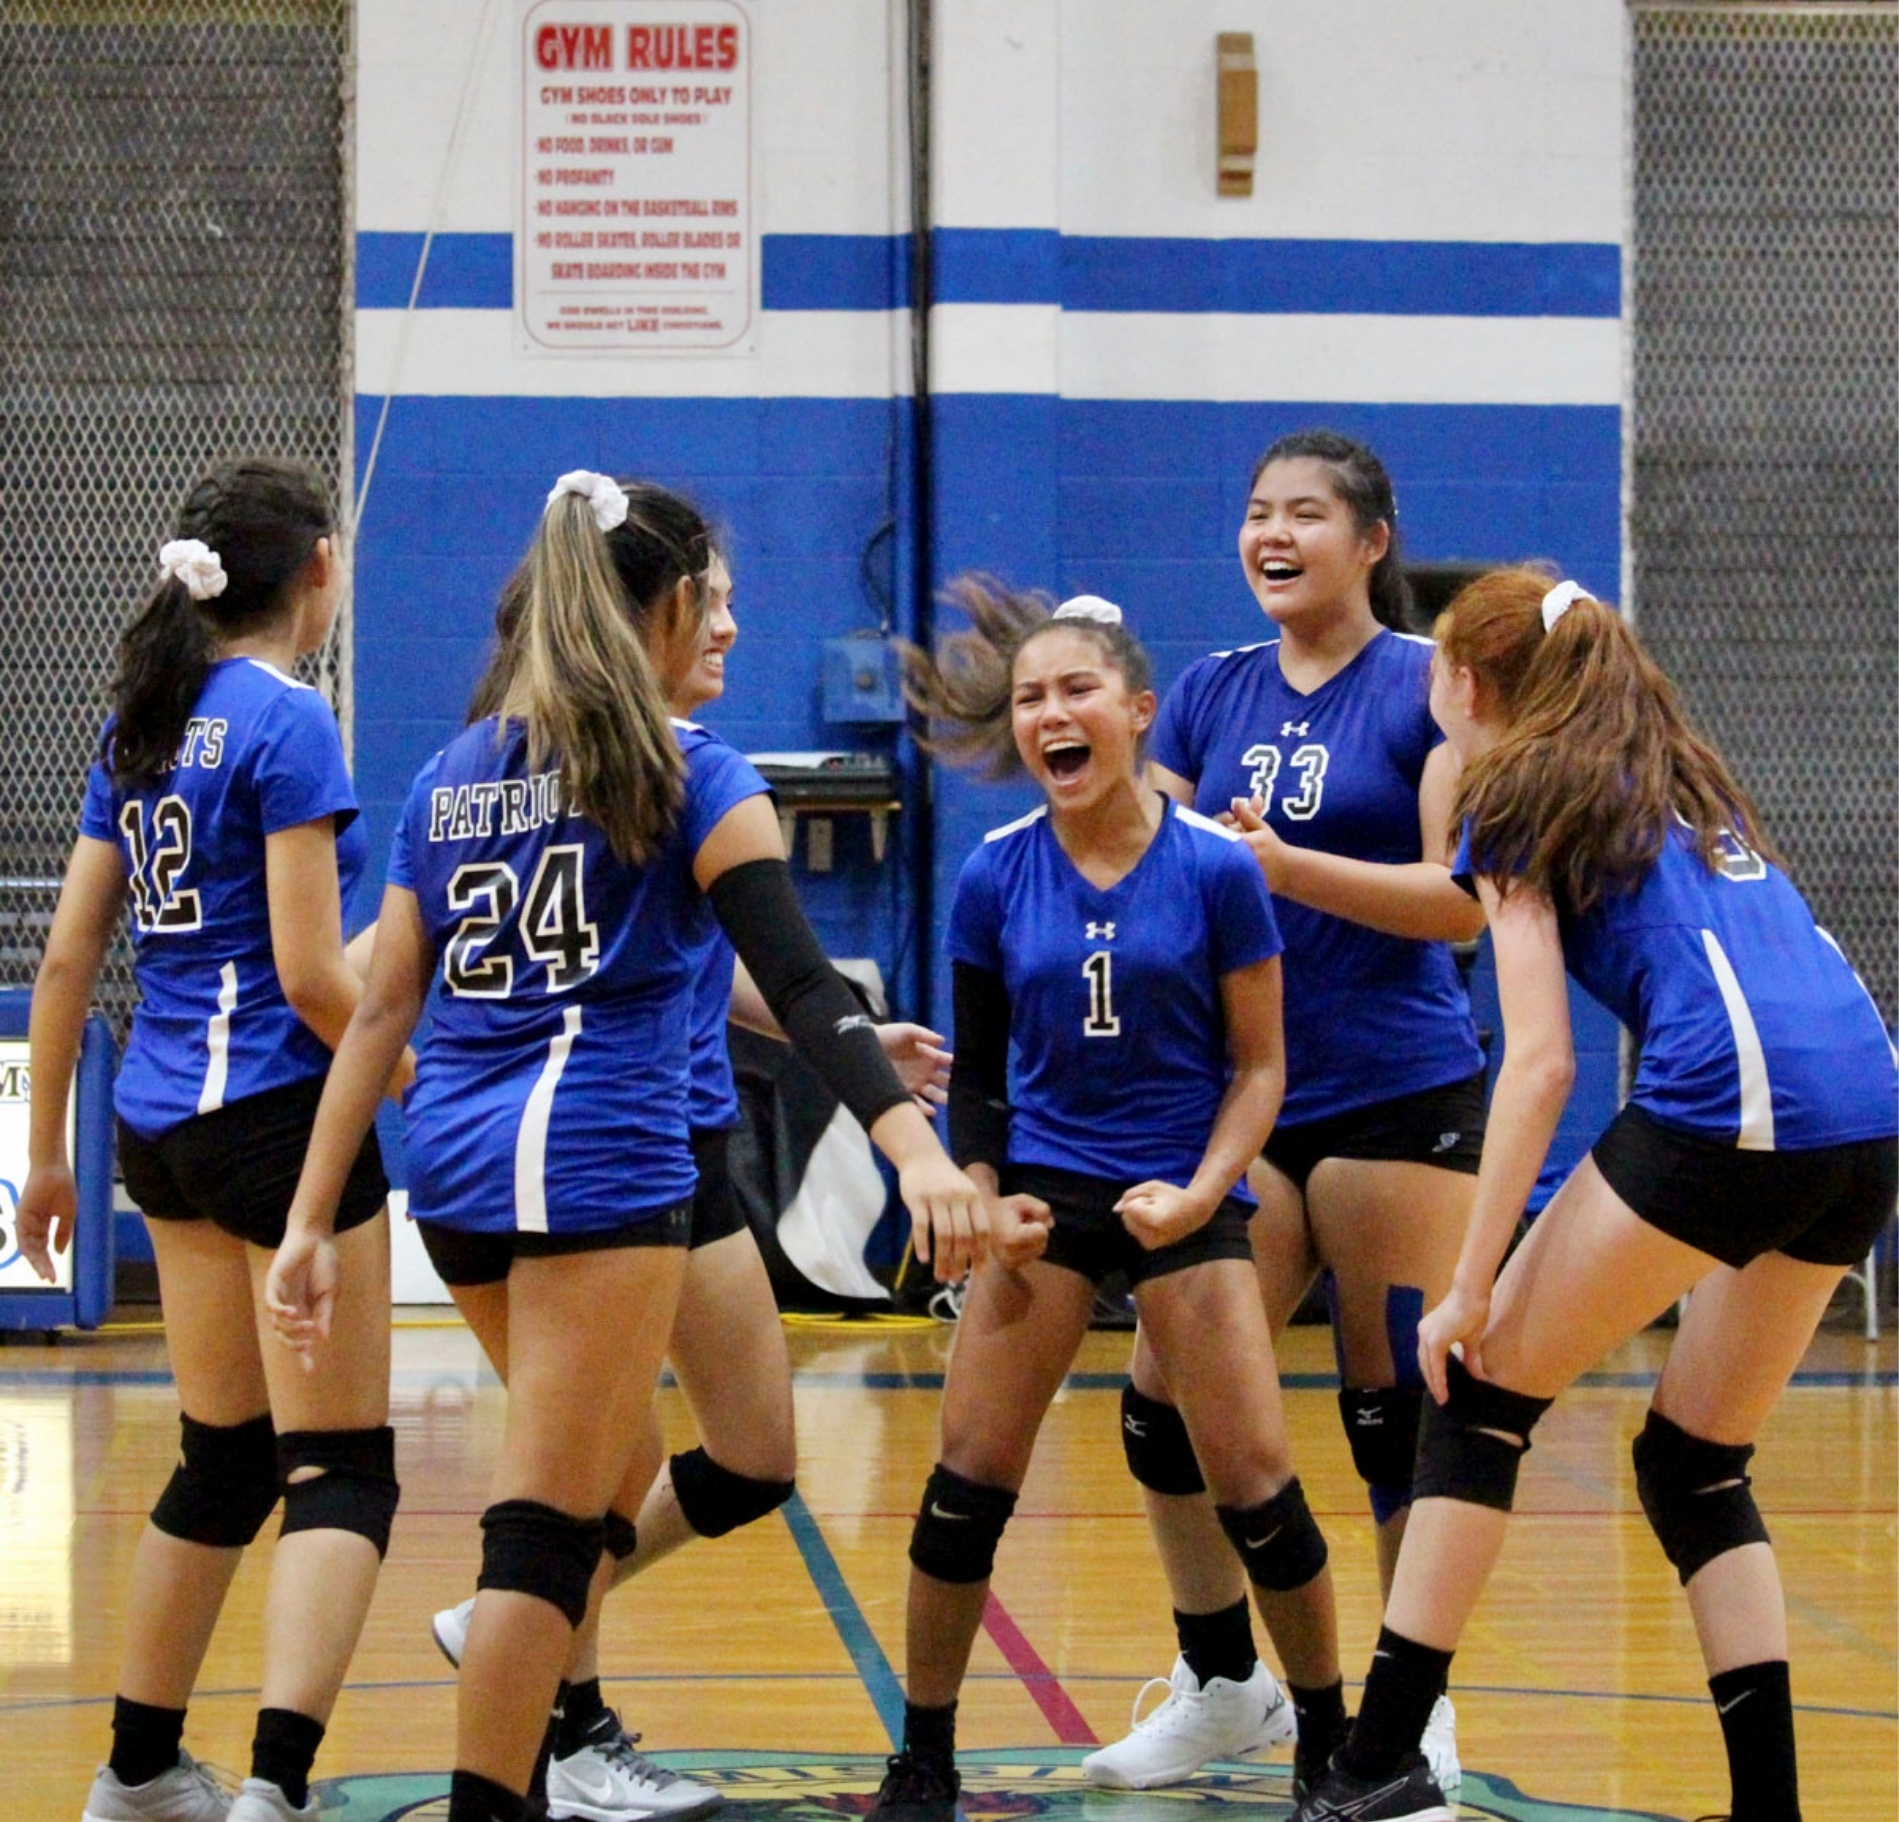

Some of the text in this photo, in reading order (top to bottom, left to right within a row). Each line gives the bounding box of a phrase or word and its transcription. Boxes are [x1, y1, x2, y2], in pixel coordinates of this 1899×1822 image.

[535, 25, 738, 71] GYM RULES
[540, 86, 732, 105] GYM SHOES ONLY TO PLAY
[590, 112, 628, 125] BLACK
[634, 136, 648, 154] OR
[651, 136, 673, 154] GUM
[556, 168, 614, 186] PROFANITY
[556, 199, 601, 216] HANGING
[604, 199, 618, 216] ON
[621, 199, 640, 216] THE
[643, 199, 708, 216] BASKETBALL
[711, 199, 738, 216] RIMS
[556, 231, 594, 249] ROLLER
[641, 231, 680, 249] ROLLER
[683, 231, 723, 249] BLADES
[726, 231, 741, 249] OR
[551, 262, 726, 279] SKATE BOARDING INSIDE THE GYM
[627, 319, 660, 333] LIKE
[1231, 743, 1330, 822] 33
[428, 770, 584, 842] PATRIO
[118, 794, 202, 933] 12
[443, 843, 600, 999] 24
[1082, 950, 1121, 1037] 1
